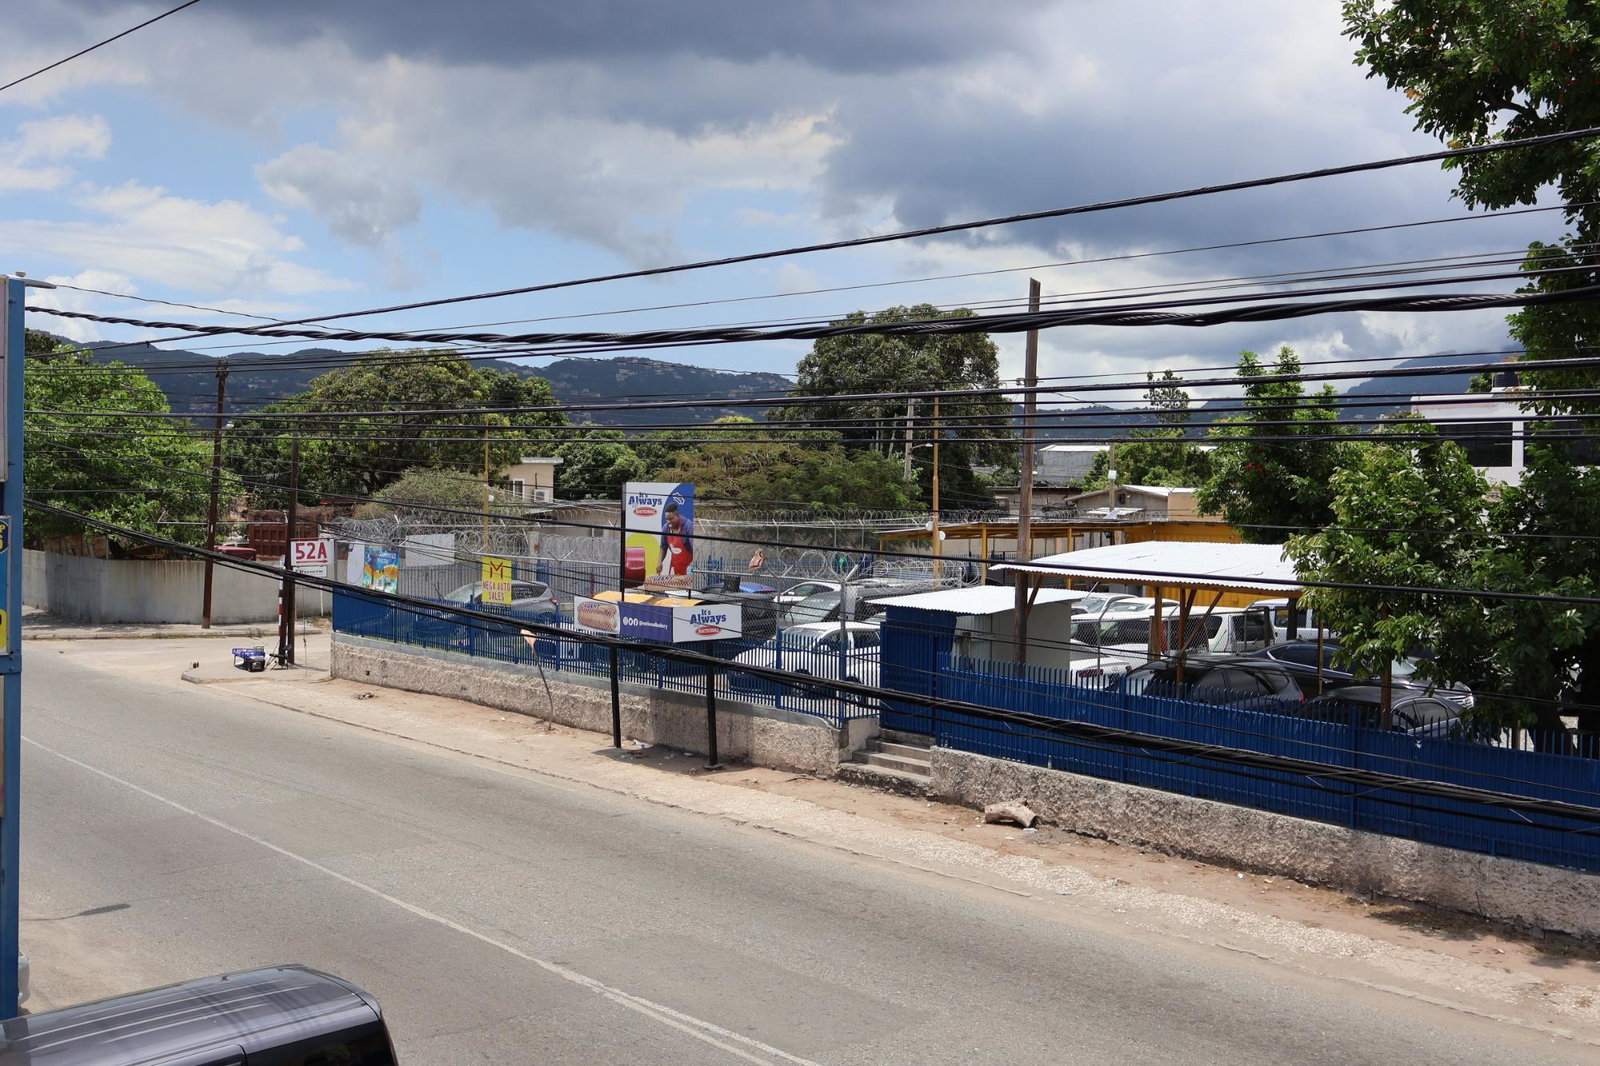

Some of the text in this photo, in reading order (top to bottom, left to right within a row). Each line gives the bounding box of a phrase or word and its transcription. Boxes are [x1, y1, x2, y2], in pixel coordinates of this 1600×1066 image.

[628, 496, 662, 507] Always
[295, 542, 327, 560] 52A
[488, 591, 505, 601] SALES
[689, 614, 727, 625] Always
